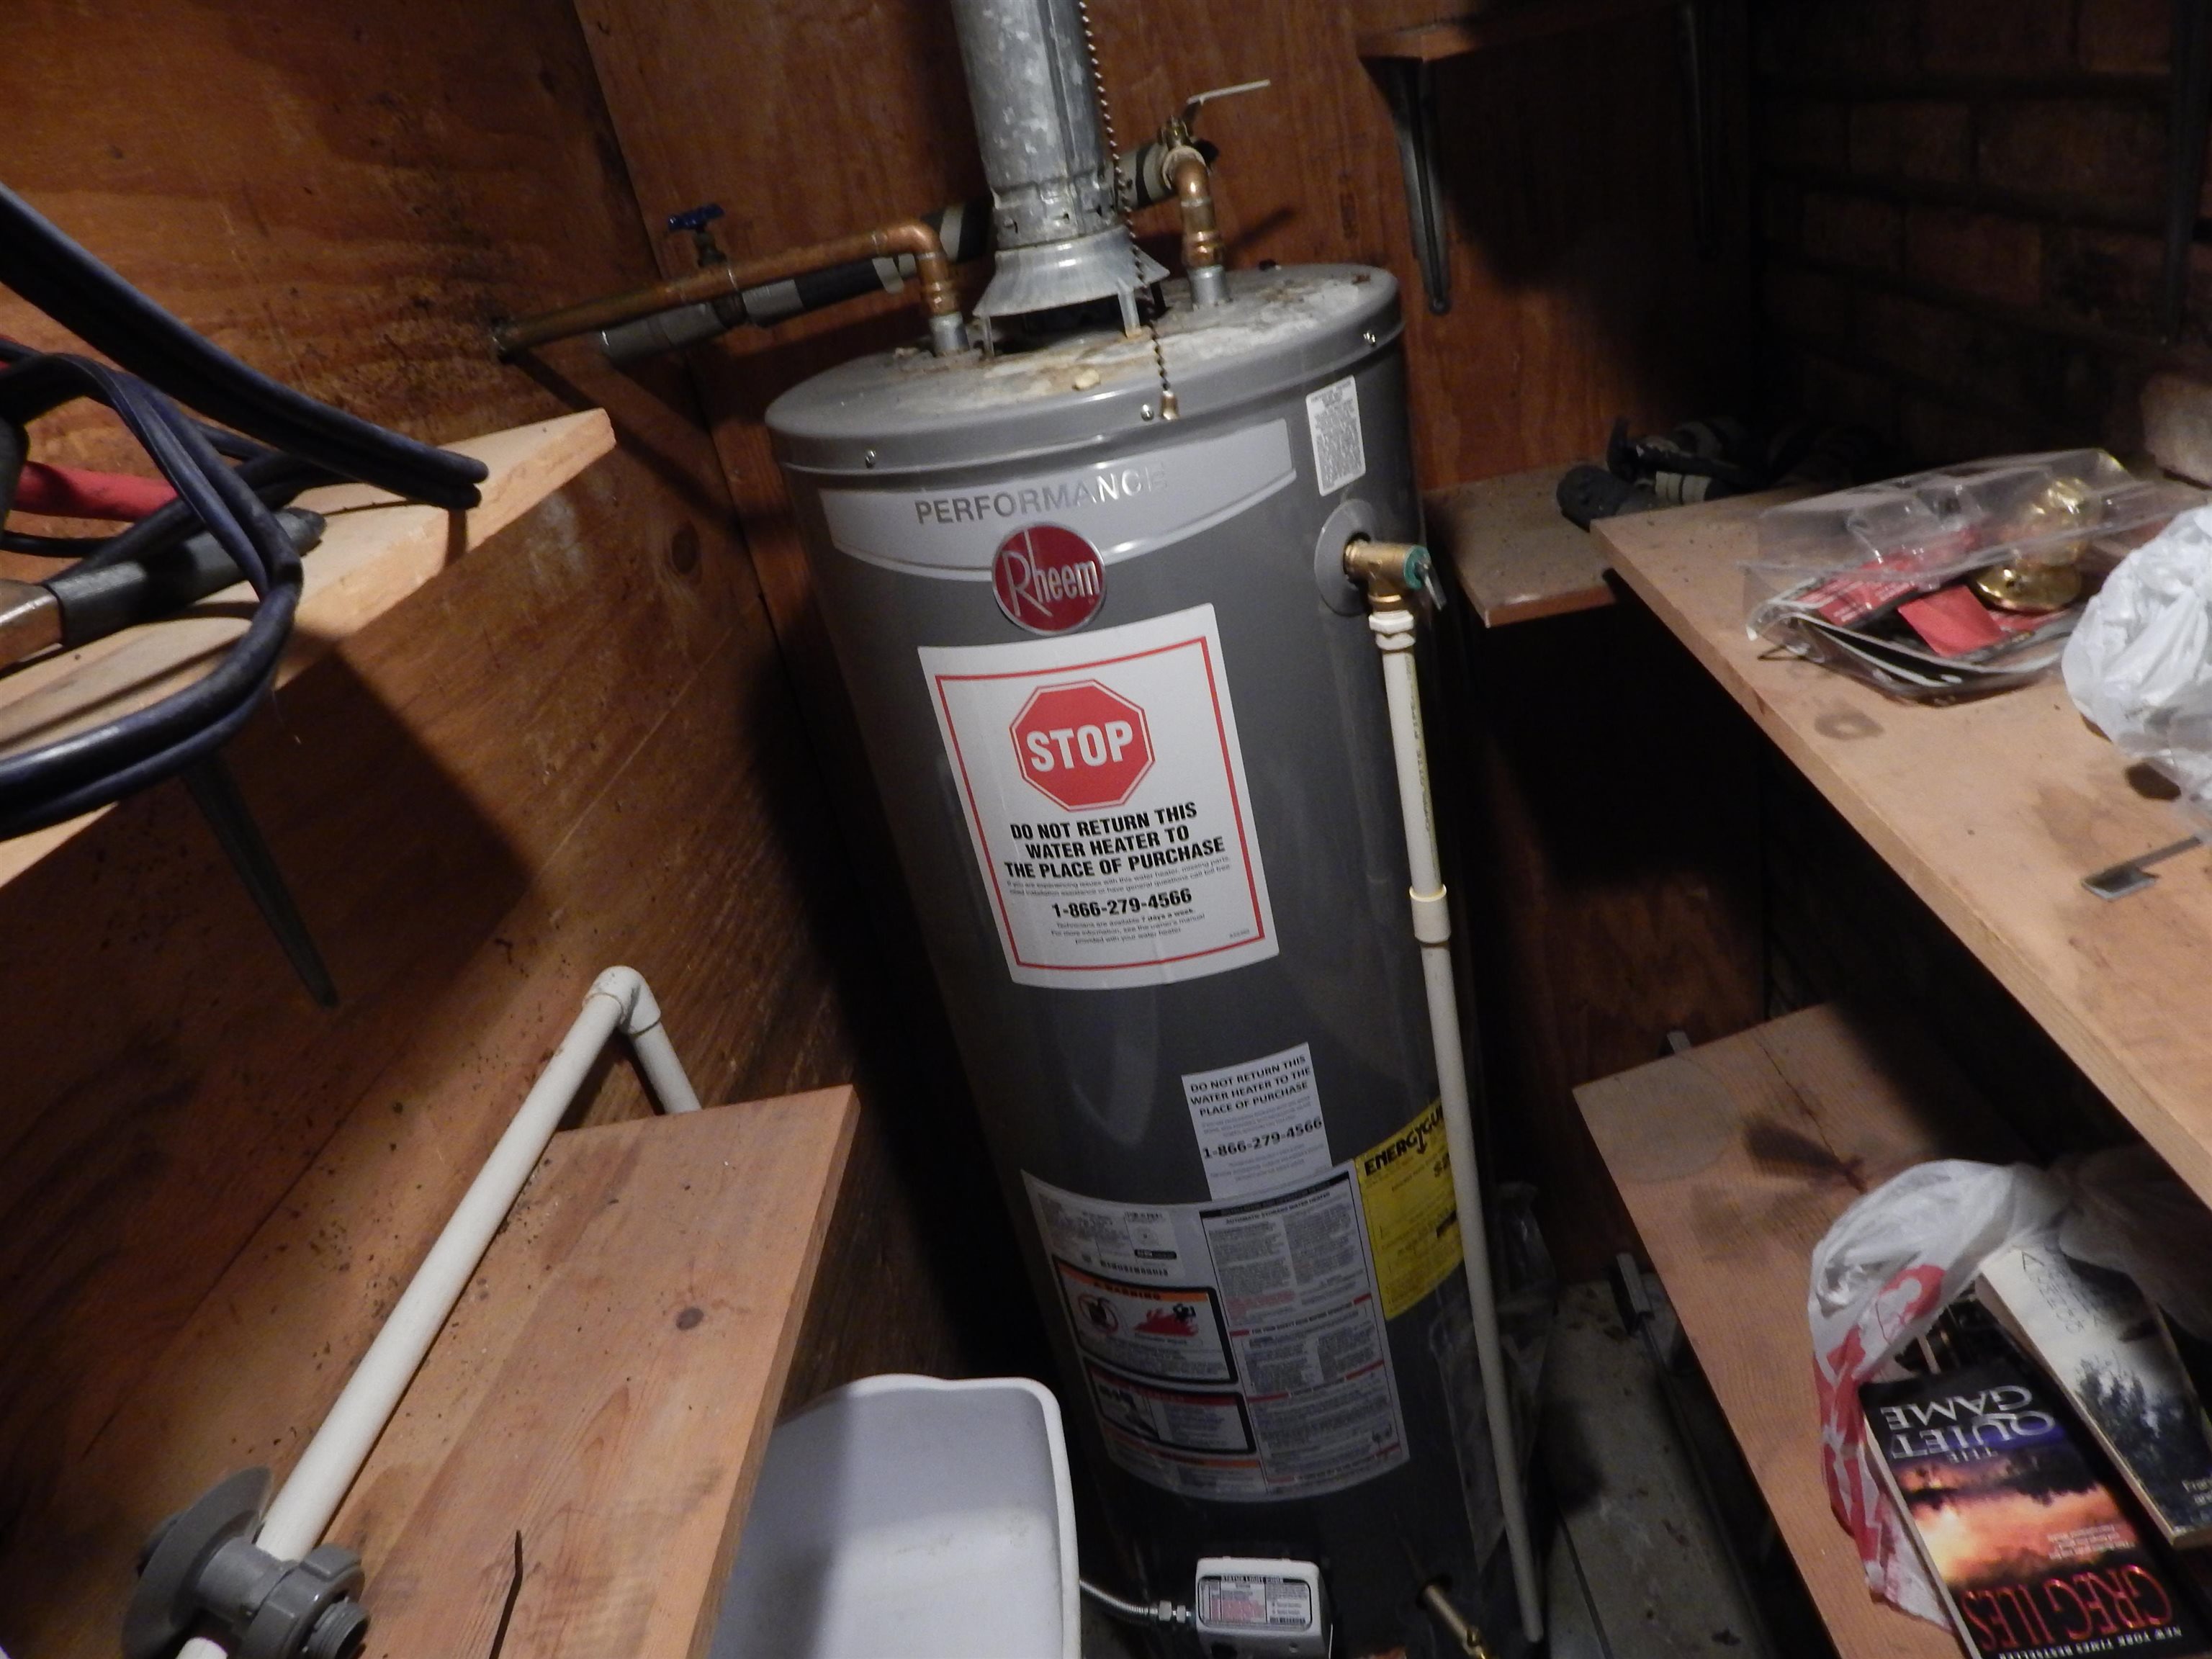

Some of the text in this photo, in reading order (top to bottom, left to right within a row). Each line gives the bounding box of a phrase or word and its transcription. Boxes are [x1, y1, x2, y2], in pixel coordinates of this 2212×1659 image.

[914, 462, 1167, 525] PERFORMANCE
[1001, 529, 1100, 617] Rheem
[1026, 720, 1133, 773] STOP
[1010, 801, 1197, 840] DO NOT RETURN THIS
[1004, 837, 1226, 878] THE PLACE OF PURCHASE
[1025, 825, 1190, 859] WATER HEATER TO
[1052, 888, 1192, 918] 1-866-279-4566
[1190, 1054, 1305, 1093] DO NOT RETURN THIS
[1190, 1067, 1311, 1105] WATER HEATER TO THE
[1200, 1081, 1308, 1117] PLACE OF PURCHASE
[1203, 1117, 1322, 1159] 1-866-279-4566
[1880, 1385, 2033, 1431] GAME
[1890, 1410, 2056, 1459] QUIET
[1947, 1446, 1998, 1463] THE
[1961, 1564, 2172, 1652] GREG ILES
[2076, 1637, 2114, 1655] TIMES
[2117, 1631, 2151, 1648] YORK
[2154, 1626, 2182, 1641] NEW
